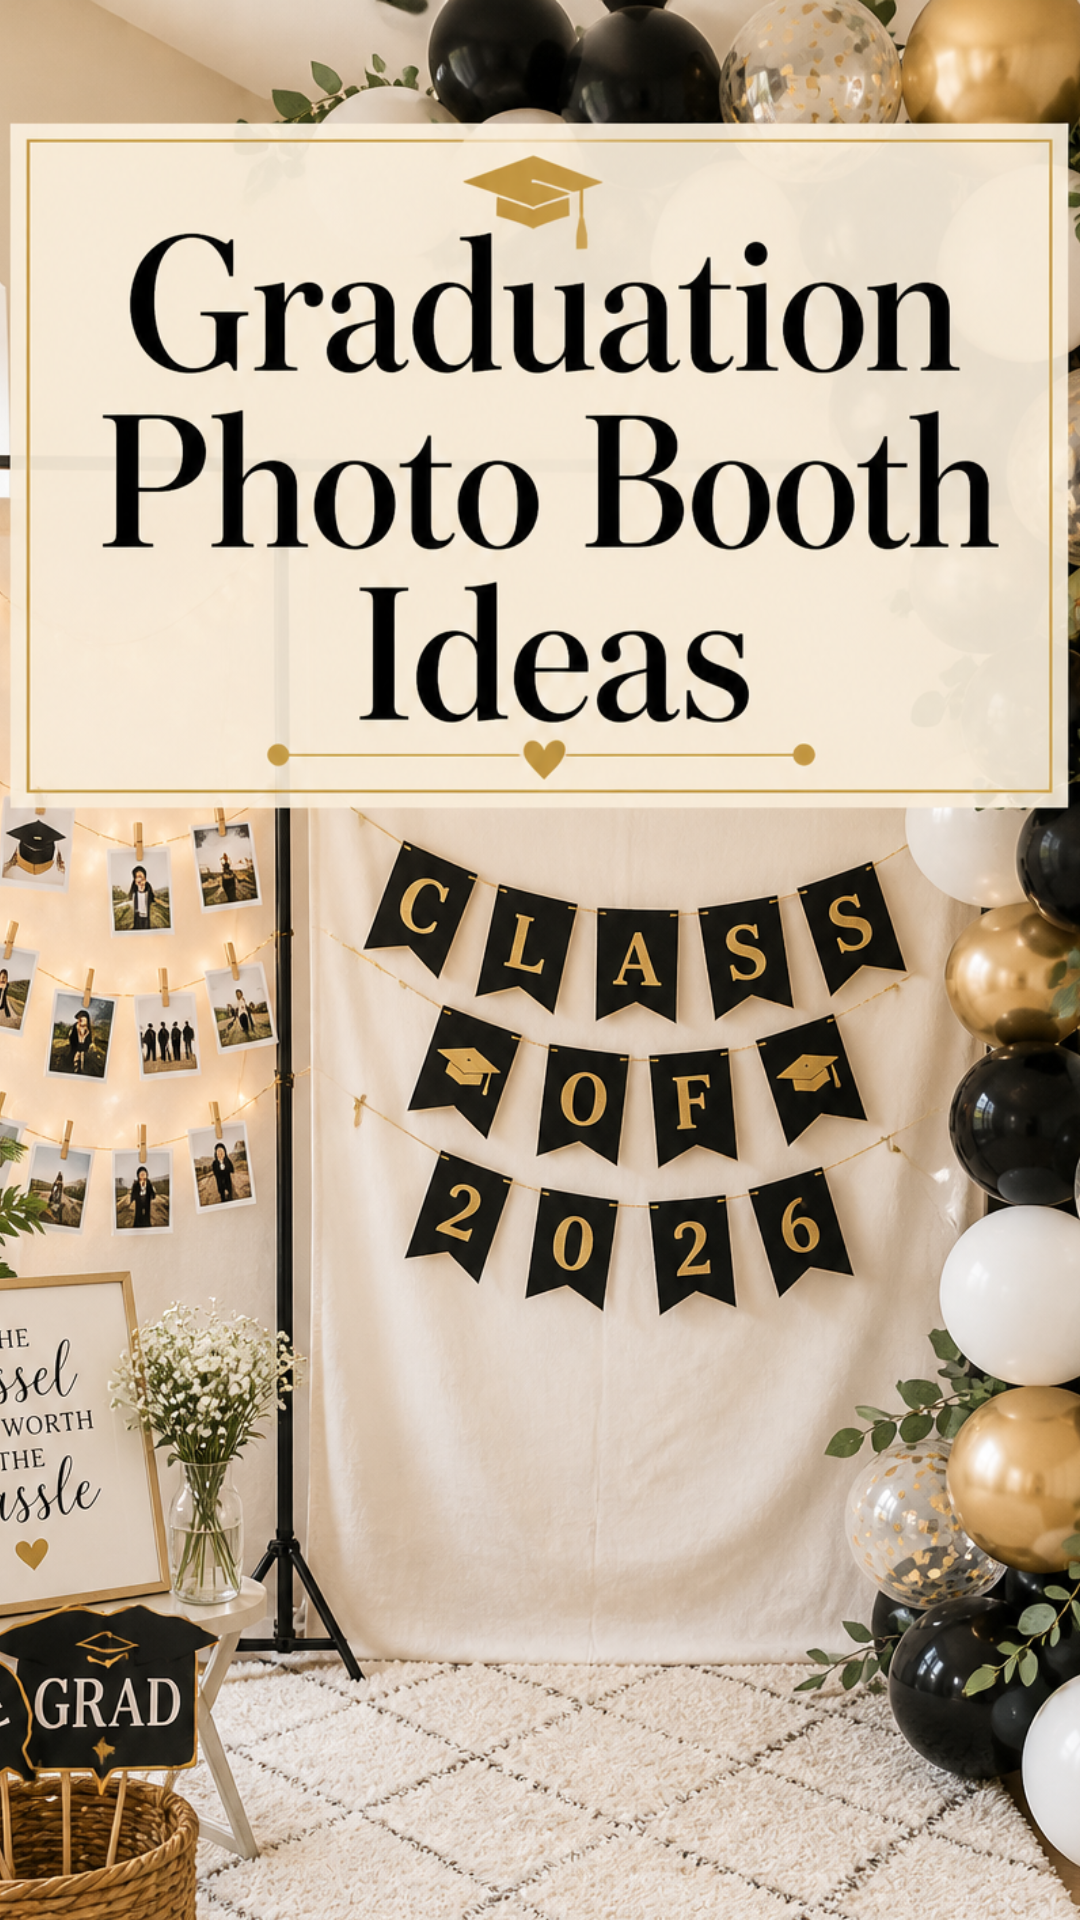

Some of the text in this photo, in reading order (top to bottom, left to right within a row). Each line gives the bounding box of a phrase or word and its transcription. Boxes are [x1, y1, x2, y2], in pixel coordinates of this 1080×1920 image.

[399, 878, 873, 986] CLASS
[560, 1071, 711, 1130] OF
[435, 1183, 820, 1277] 2026
[1, 1409, 94, 1437] WORTH
[0, 1447, 46, 1472] THE
[34, 1677, 181, 1730] GRAD
